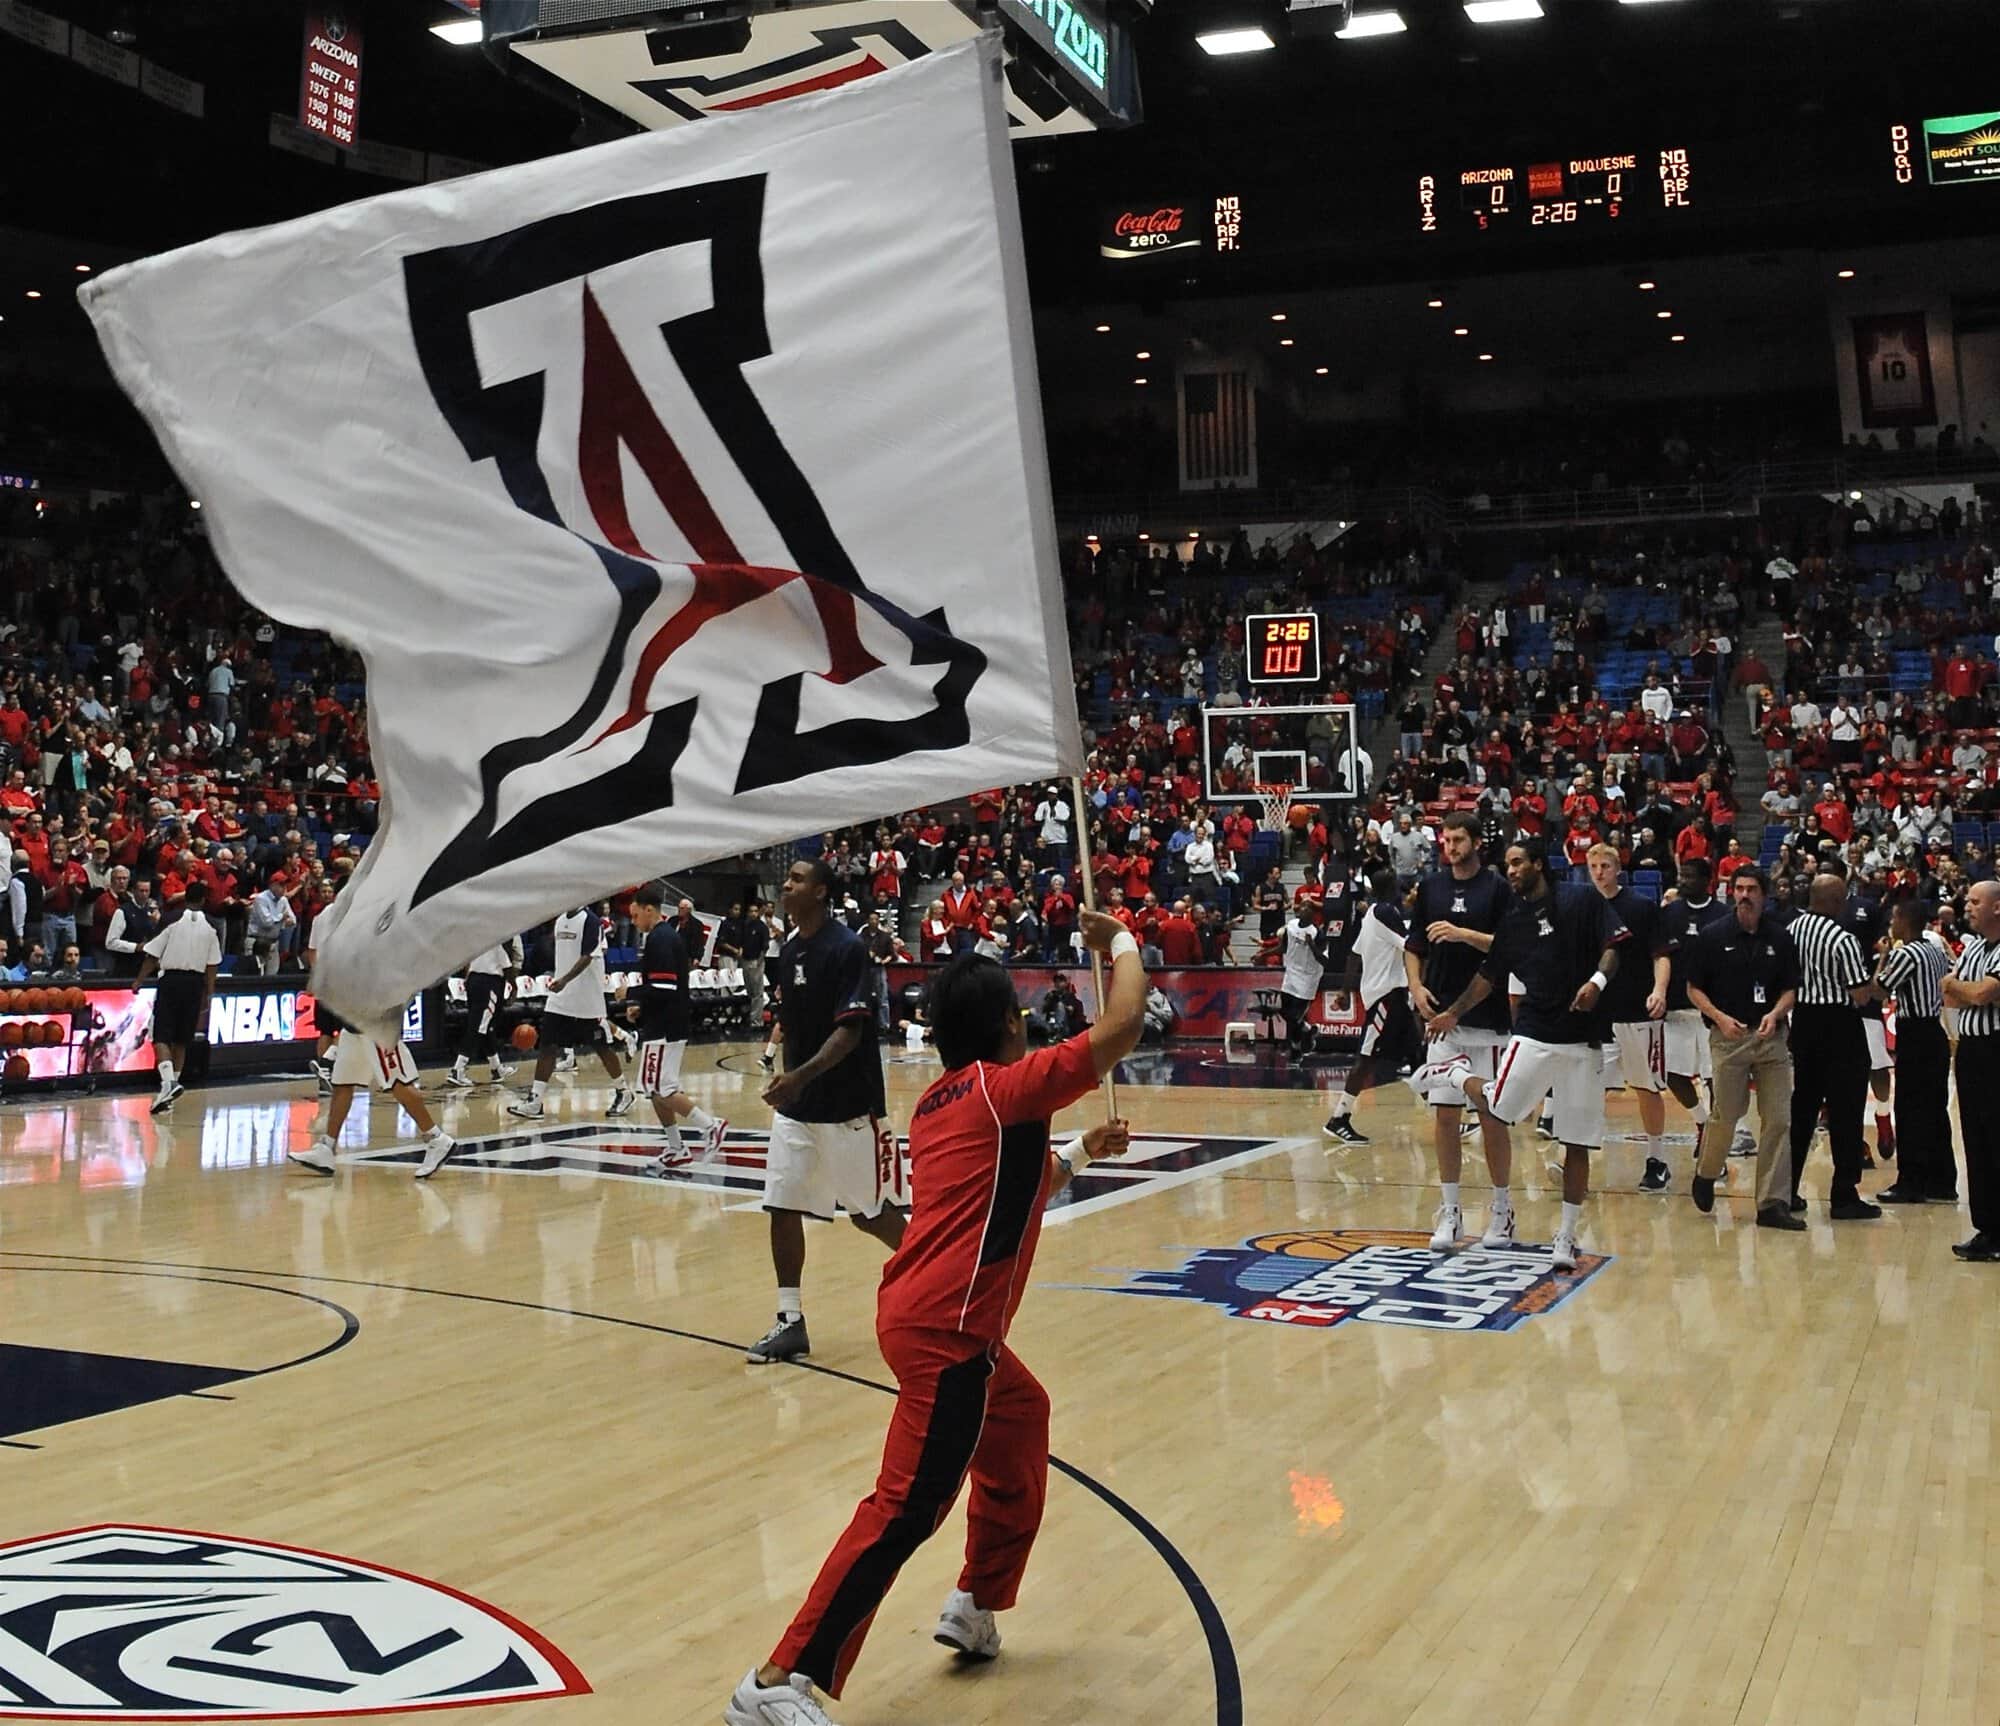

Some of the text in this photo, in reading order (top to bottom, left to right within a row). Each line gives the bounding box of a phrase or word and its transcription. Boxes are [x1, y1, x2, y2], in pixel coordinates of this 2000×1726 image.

[310, 35, 359, 69] ARIZONA
[309, 61, 355, 92] SWEET 16
[309, 80, 354, 110] 1976 1988
[308, 97, 352, 126] 1989 1991
[307, 113, 352, 143] 1994 1996
[1660, 149, 1687, 165] NO
[1931, 146, 1974, 160] BRIGHT
[1569, 155, 1636, 175] DUQUESNE
[1659, 163, 1690, 180] PTS
[1461, 168, 1513, 185] ARIZONA
[1663, 178, 1689, 193] RB
[1216, 197, 1239, 211] NO
[1420, 176, 1436, 231] ARIZ
[1664, 192, 1690, 207] FL
[1214, 209, 1241, 224] PTS
[1531, 202, 1577, 224] 2:26
[1217, 223, 1239, 237] RB
[1882, 360, 1906, 382] 10
[1266, 622, 1310, 642] 2:26
[1265, 645, 1302, 674] 00
[208, 990, 322, 1045] NBA 2
[879, 1130, 893, 1183] CATS
[1276, 1245, 1446, 1306] SPORTS
[1356, 1245, 1556, 1330] CLASSI
